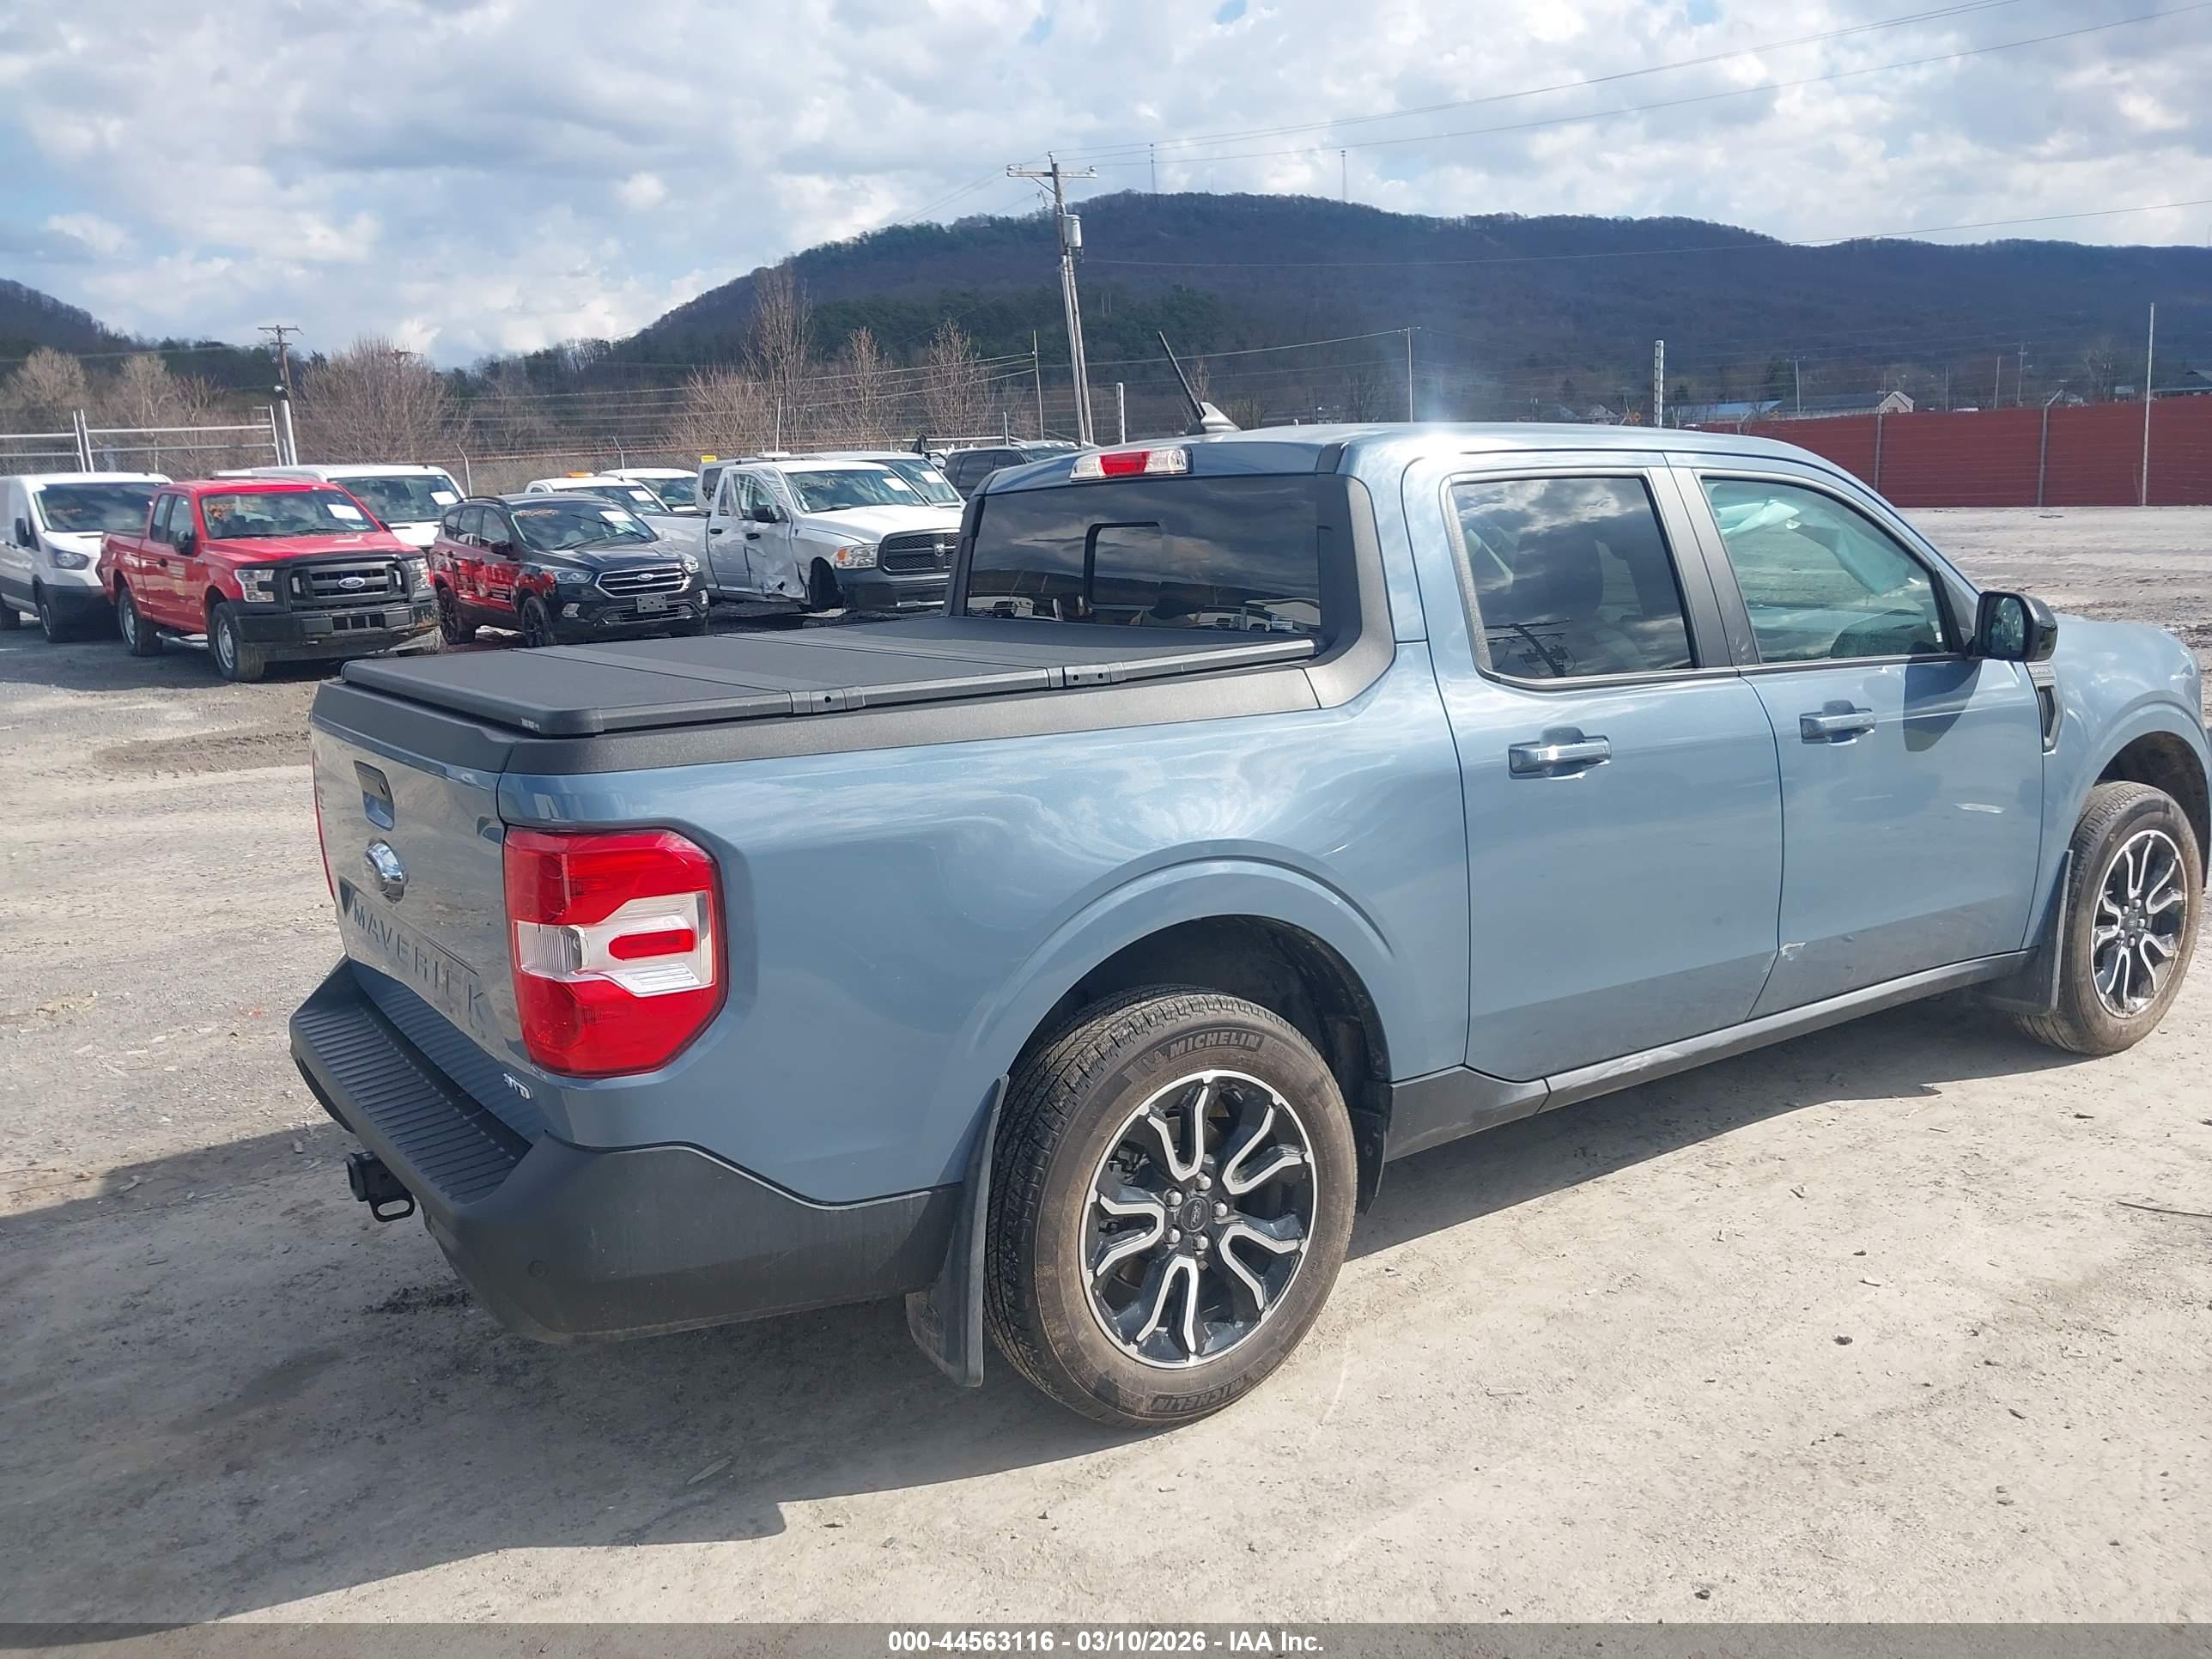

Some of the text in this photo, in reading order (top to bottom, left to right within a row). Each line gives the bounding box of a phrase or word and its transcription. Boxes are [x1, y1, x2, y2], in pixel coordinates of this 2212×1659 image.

[353, 897, 489, 1030] MAVERICK
[1170, 1031, 1260, 1059] MICHELIN
[1152, 1375, 1249, 1411] MICHELIN
